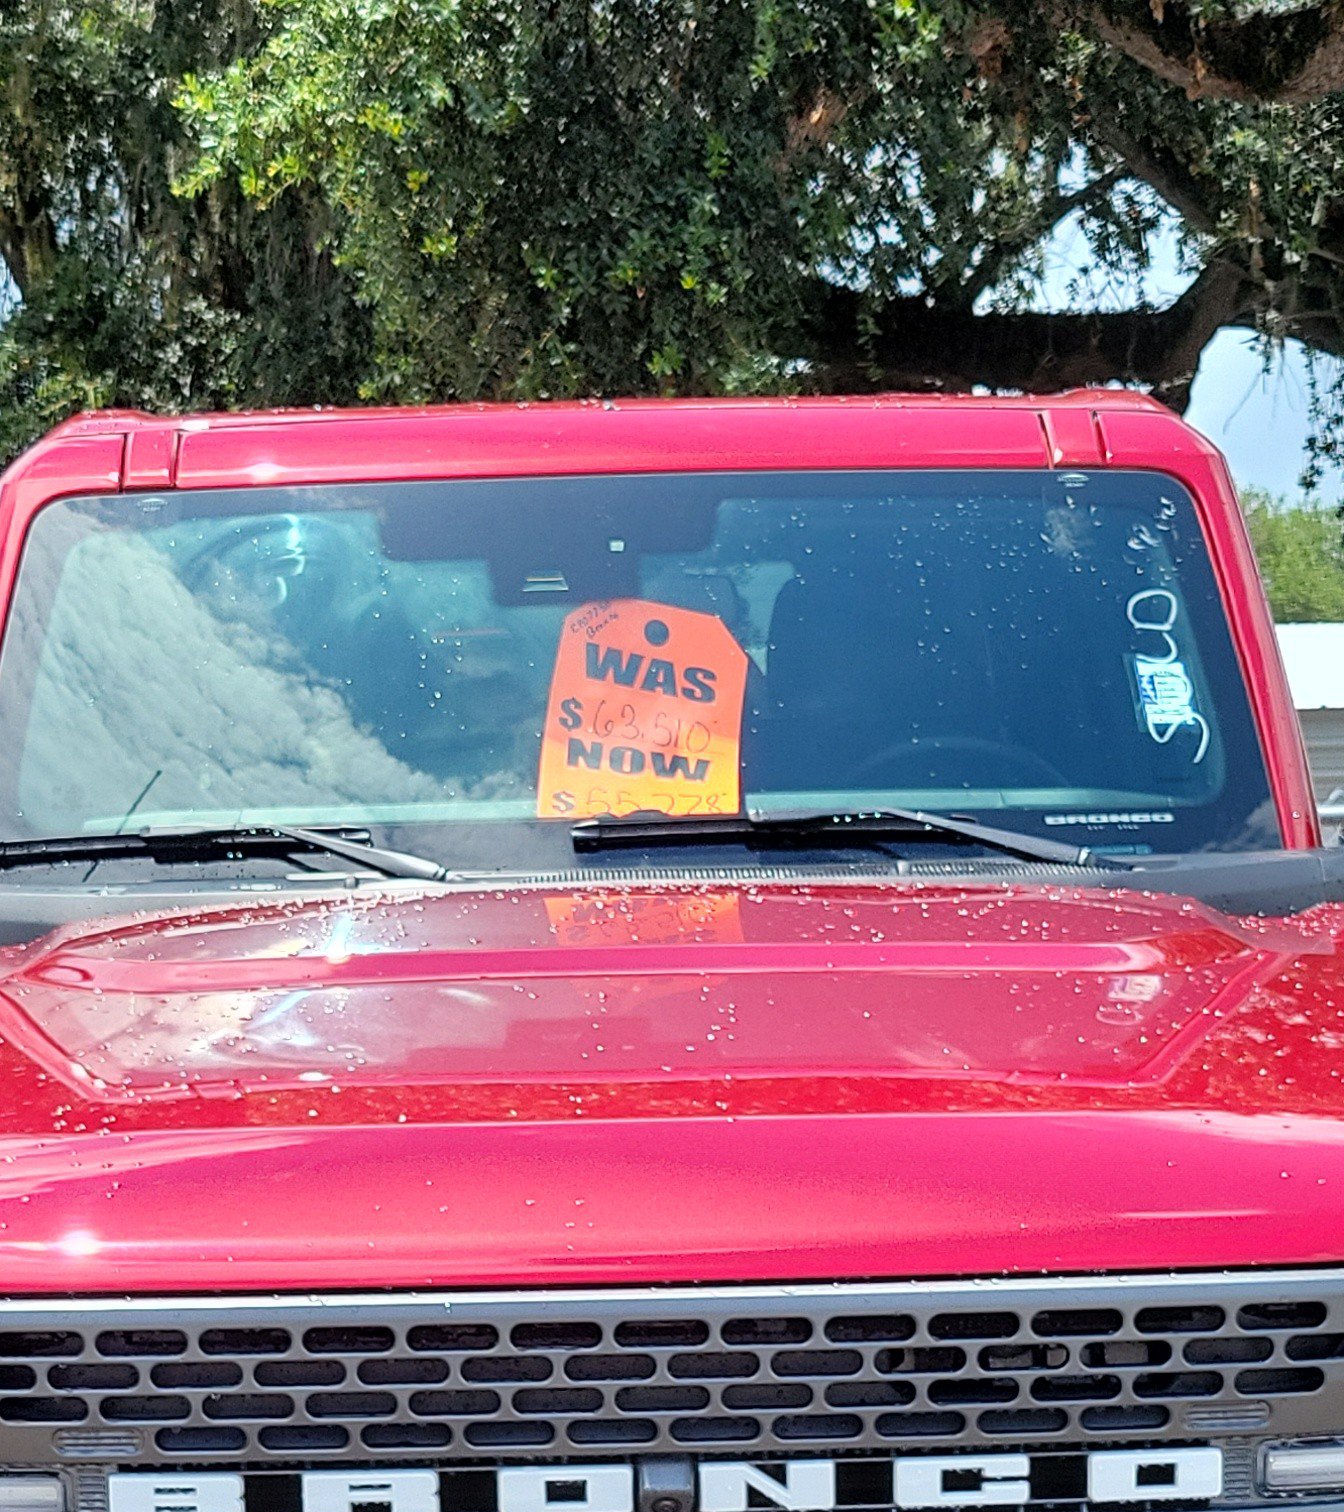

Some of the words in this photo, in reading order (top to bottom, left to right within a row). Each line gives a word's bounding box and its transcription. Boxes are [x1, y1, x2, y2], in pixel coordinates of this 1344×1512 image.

[585, 641, 718, 703] WAS
[566, 737, 711, 781] NOW
[1044, 812, 1174, 826] BRONCO
